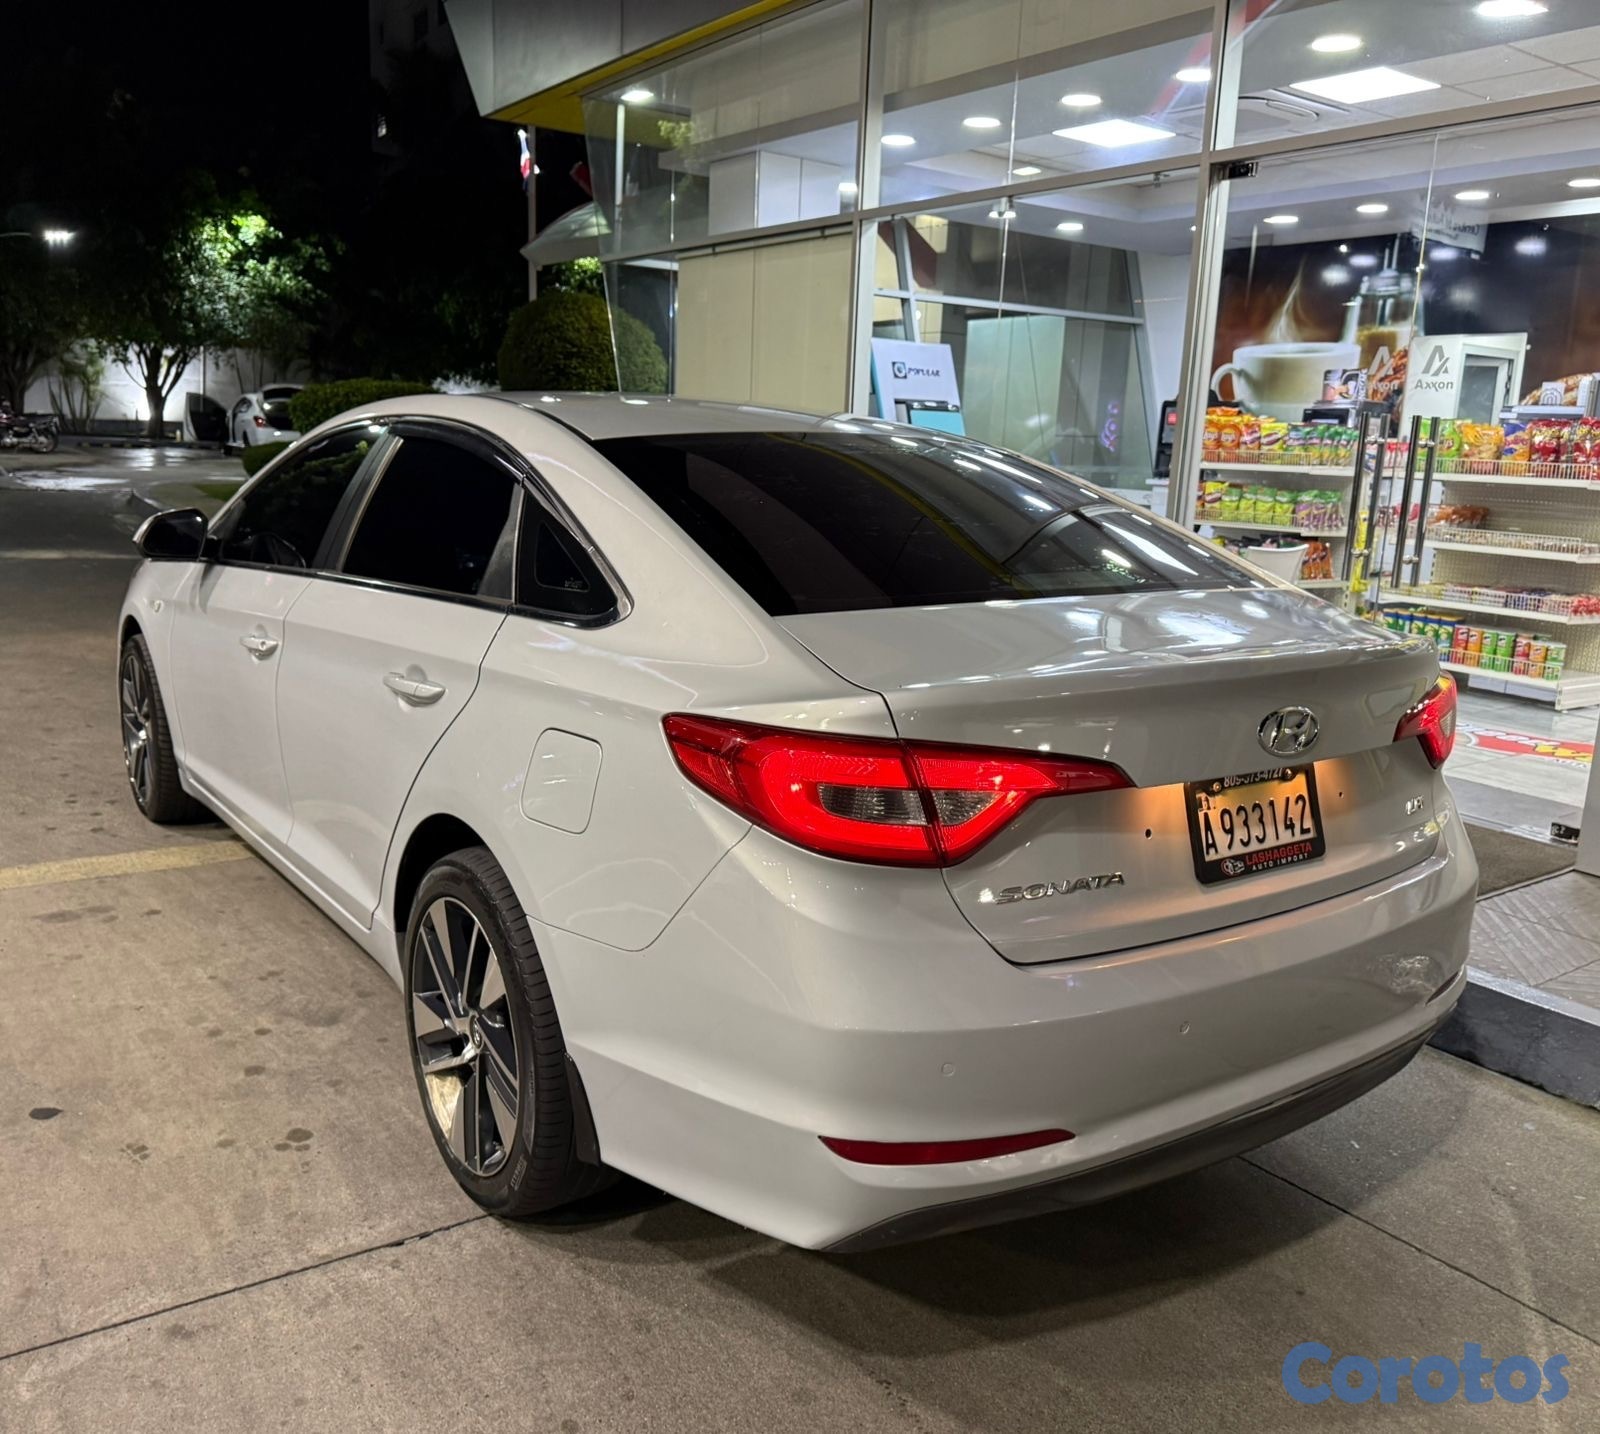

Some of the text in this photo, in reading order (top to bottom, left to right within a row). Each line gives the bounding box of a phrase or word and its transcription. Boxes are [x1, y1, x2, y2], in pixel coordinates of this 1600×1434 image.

[908, 367, 940, 377] POPULAR
[1415, 379, 1454, 392] Axxon
[1204, 794, 1311, 856] A933142
[1246, 842, 1313, 865] LASHAGGETA
[1252, 853, 1309, 871] AUTO IMPORT
[996, 871, 1125, 905] SONATA
